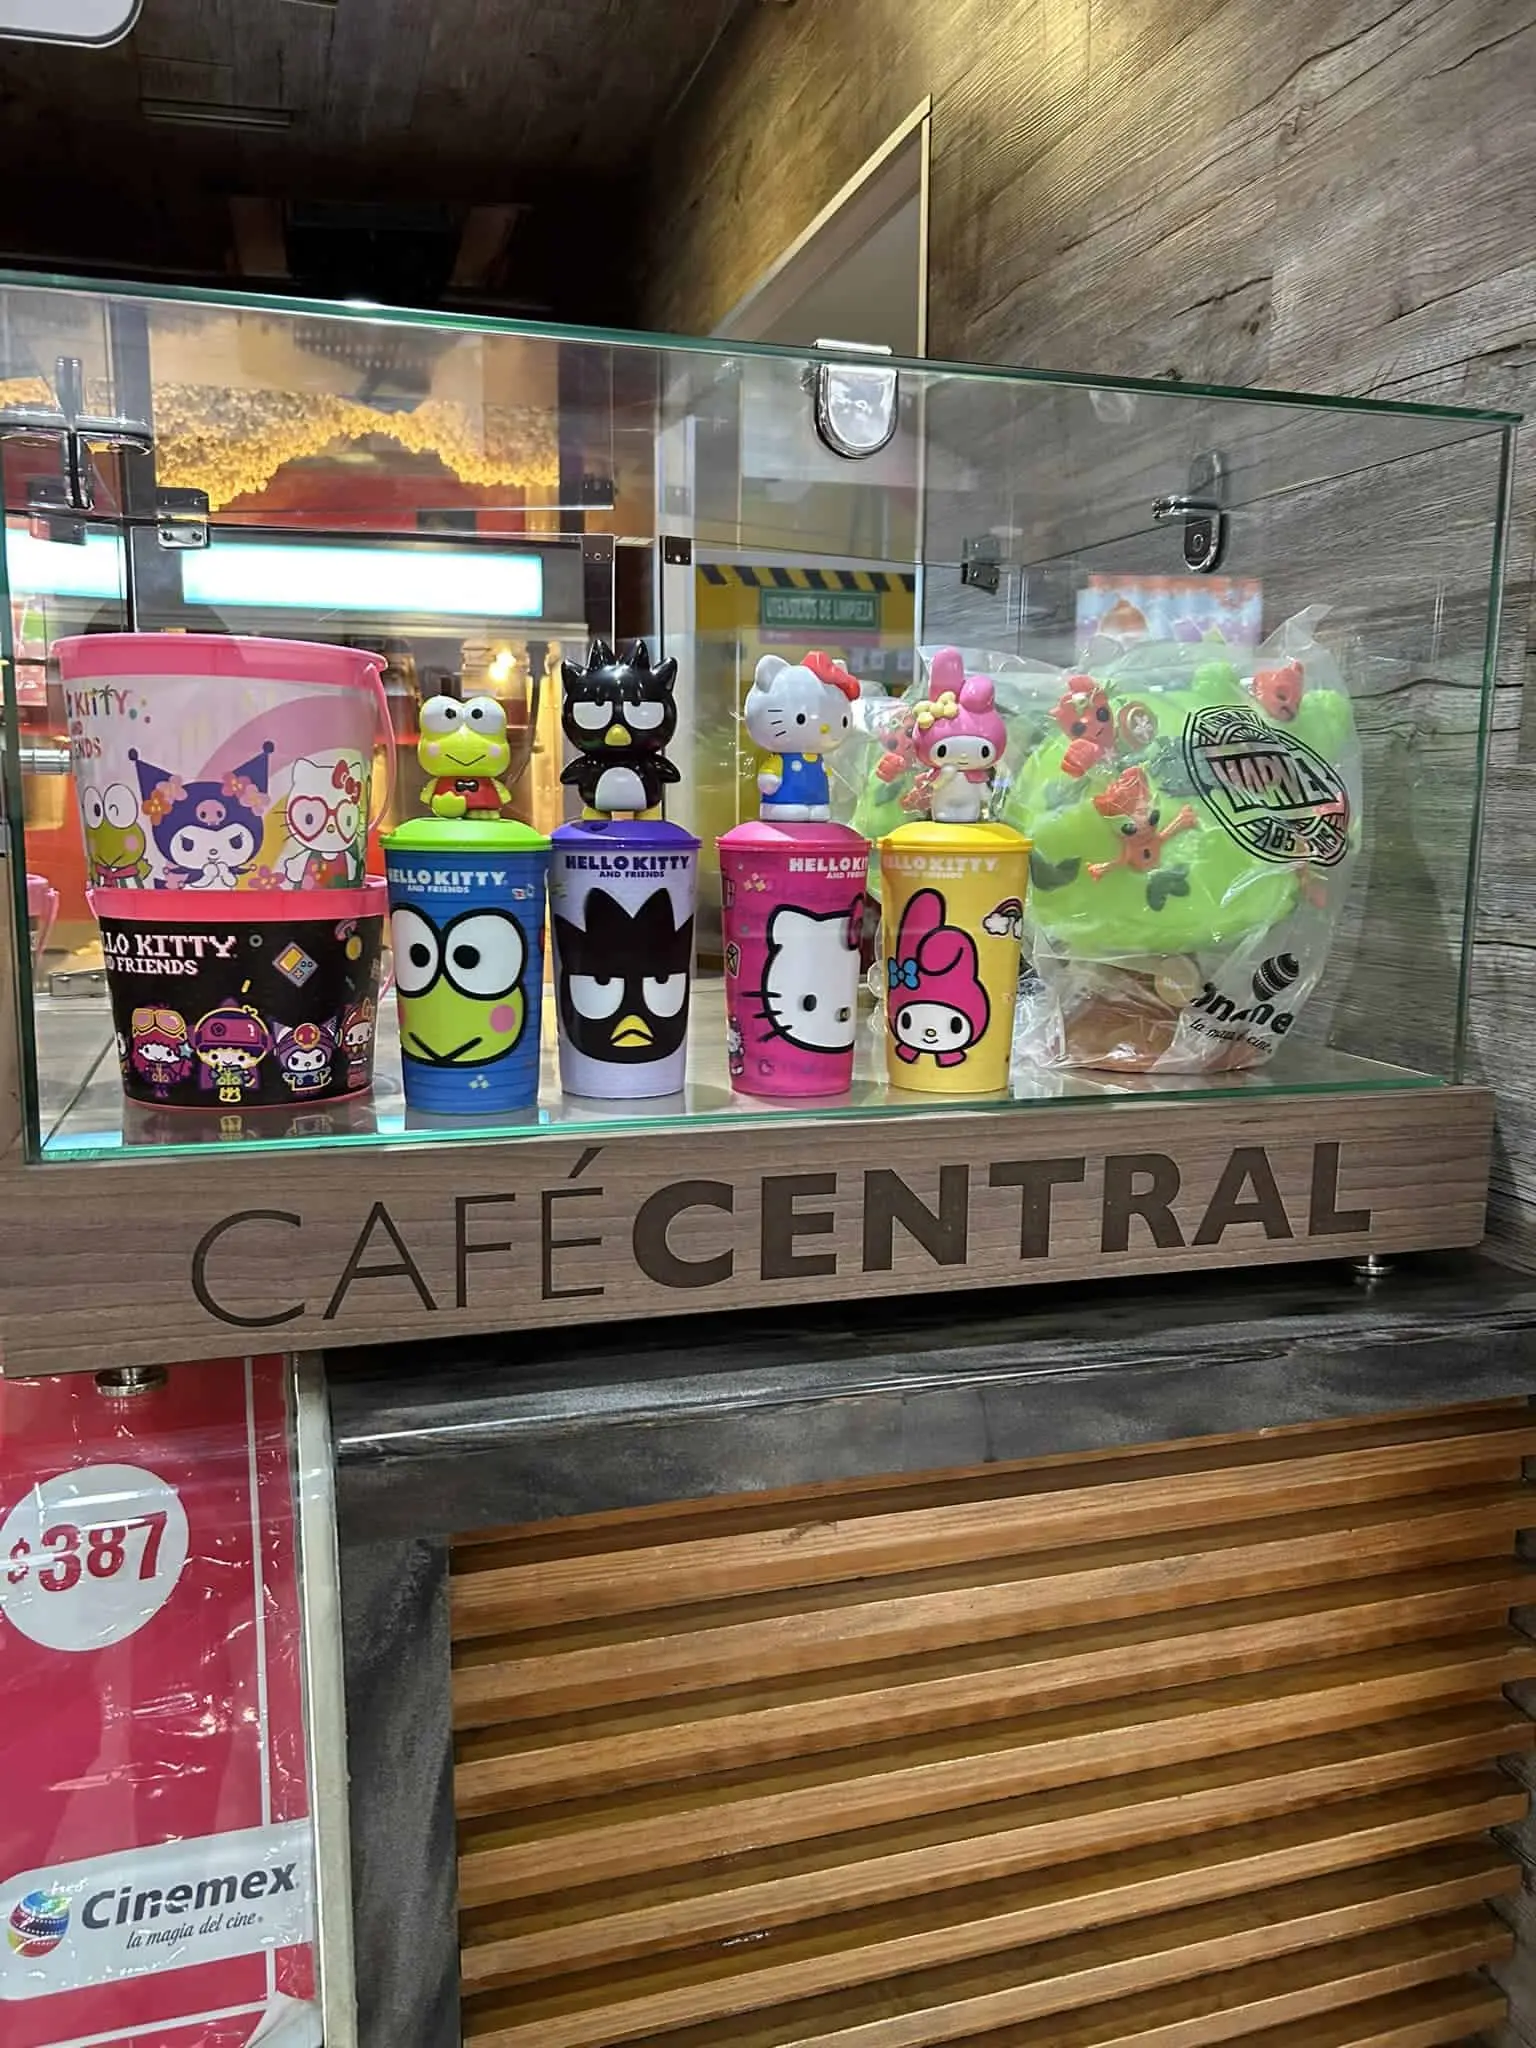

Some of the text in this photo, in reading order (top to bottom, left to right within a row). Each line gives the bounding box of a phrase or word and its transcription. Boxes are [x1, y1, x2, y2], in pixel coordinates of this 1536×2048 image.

[1207, 752, 1339, 812] MARVEL
[565, 855, 690, 870] HELLO KITTY
[789, 857, 851, 872] HELLO
[433, 870, 506, 887] KITTY
[599, 870, 665, 878] AND FRIENDS
[427, 885, 471, 894] FRIENDS
[134, 934, 237, 958] KITTY
[116, 956, 199, 976] FRIENDS
[191, 1141, 1372, 1328] CAFÉ CENTRAL
[81, 1862, 297, 1930] Cinemex
[126, 1931, 144, 1950] la
[147, 1923, 195, 1947] magia
[199, 1913, 224, 1935] del
